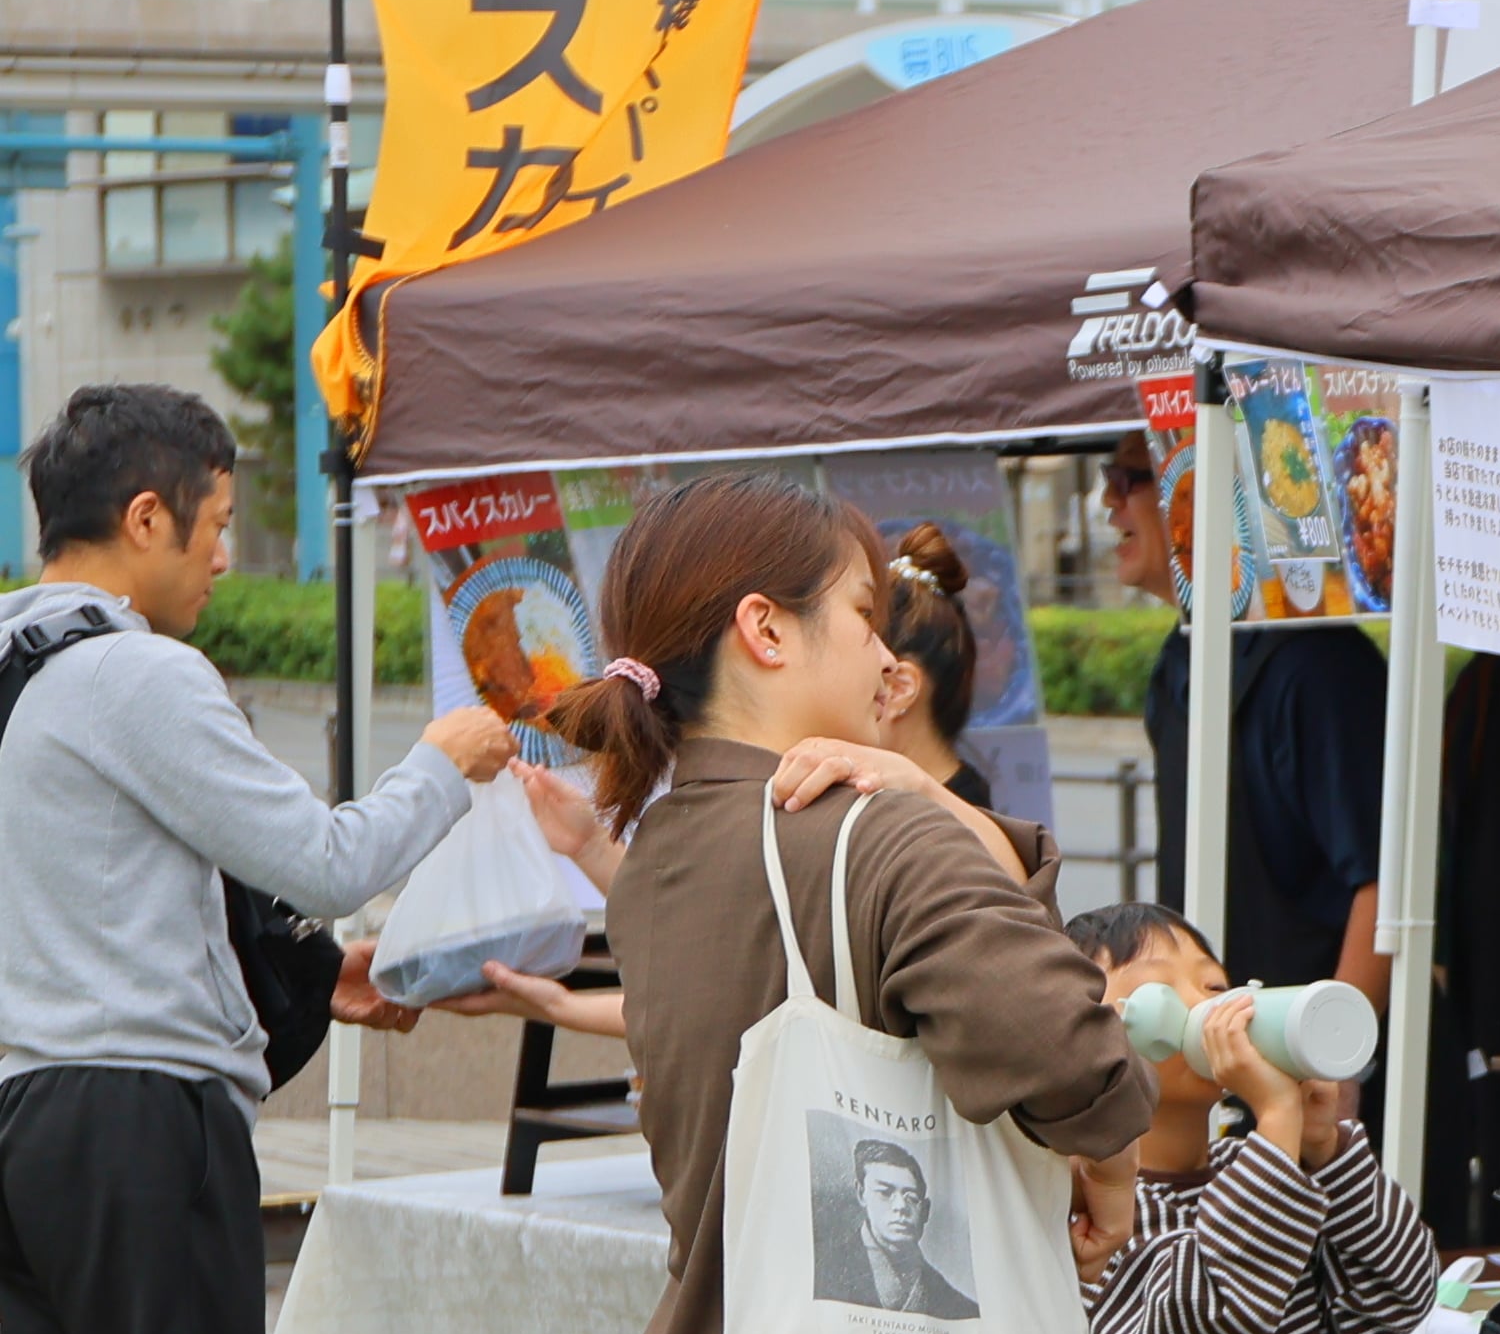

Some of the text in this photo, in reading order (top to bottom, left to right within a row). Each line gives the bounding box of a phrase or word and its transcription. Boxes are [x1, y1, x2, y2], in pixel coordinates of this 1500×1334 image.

[1068, 354, 1123, 381] Powered
[1126, 351, 1142, 375] by
[418, 488, 552, 539] スパイスカレー
[1299, 517, 1330, 547] ¥800
[834, 1089, 938, 1132] RENTARO
[848, 1313, 868, 1324] TAKI
[871, 1318, 915, 1332] RENTARO
